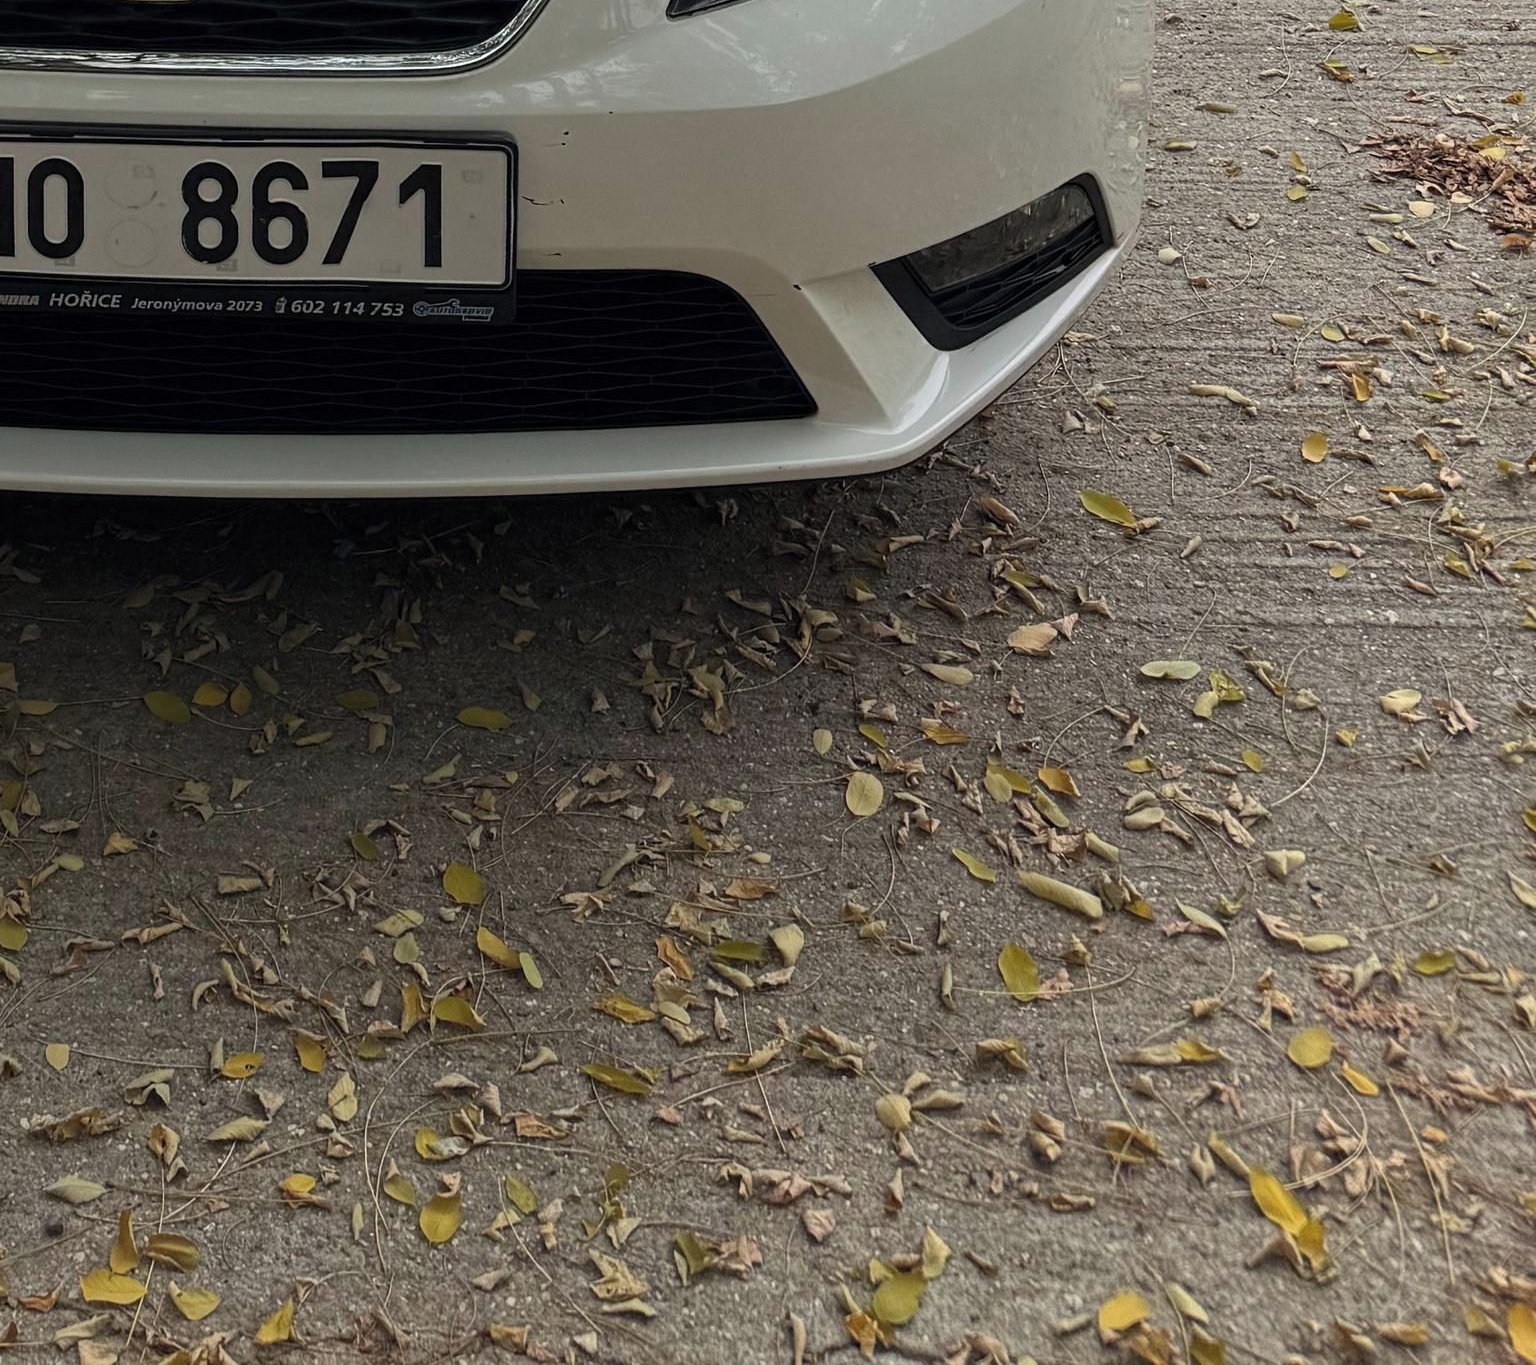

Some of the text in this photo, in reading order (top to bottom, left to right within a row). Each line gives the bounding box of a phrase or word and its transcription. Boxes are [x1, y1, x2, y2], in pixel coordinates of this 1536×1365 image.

[181, 160, 442, 268] 8671
[49, 289, 123, 309] HOŘICE
[130, 297, 223, 313] Jeronýmova
[226, 300, 264, 312] 2073
[290, 300, 325, 314] 602
[330, 301, 366, 315] 114
[369, 302, 405, 316] 753
